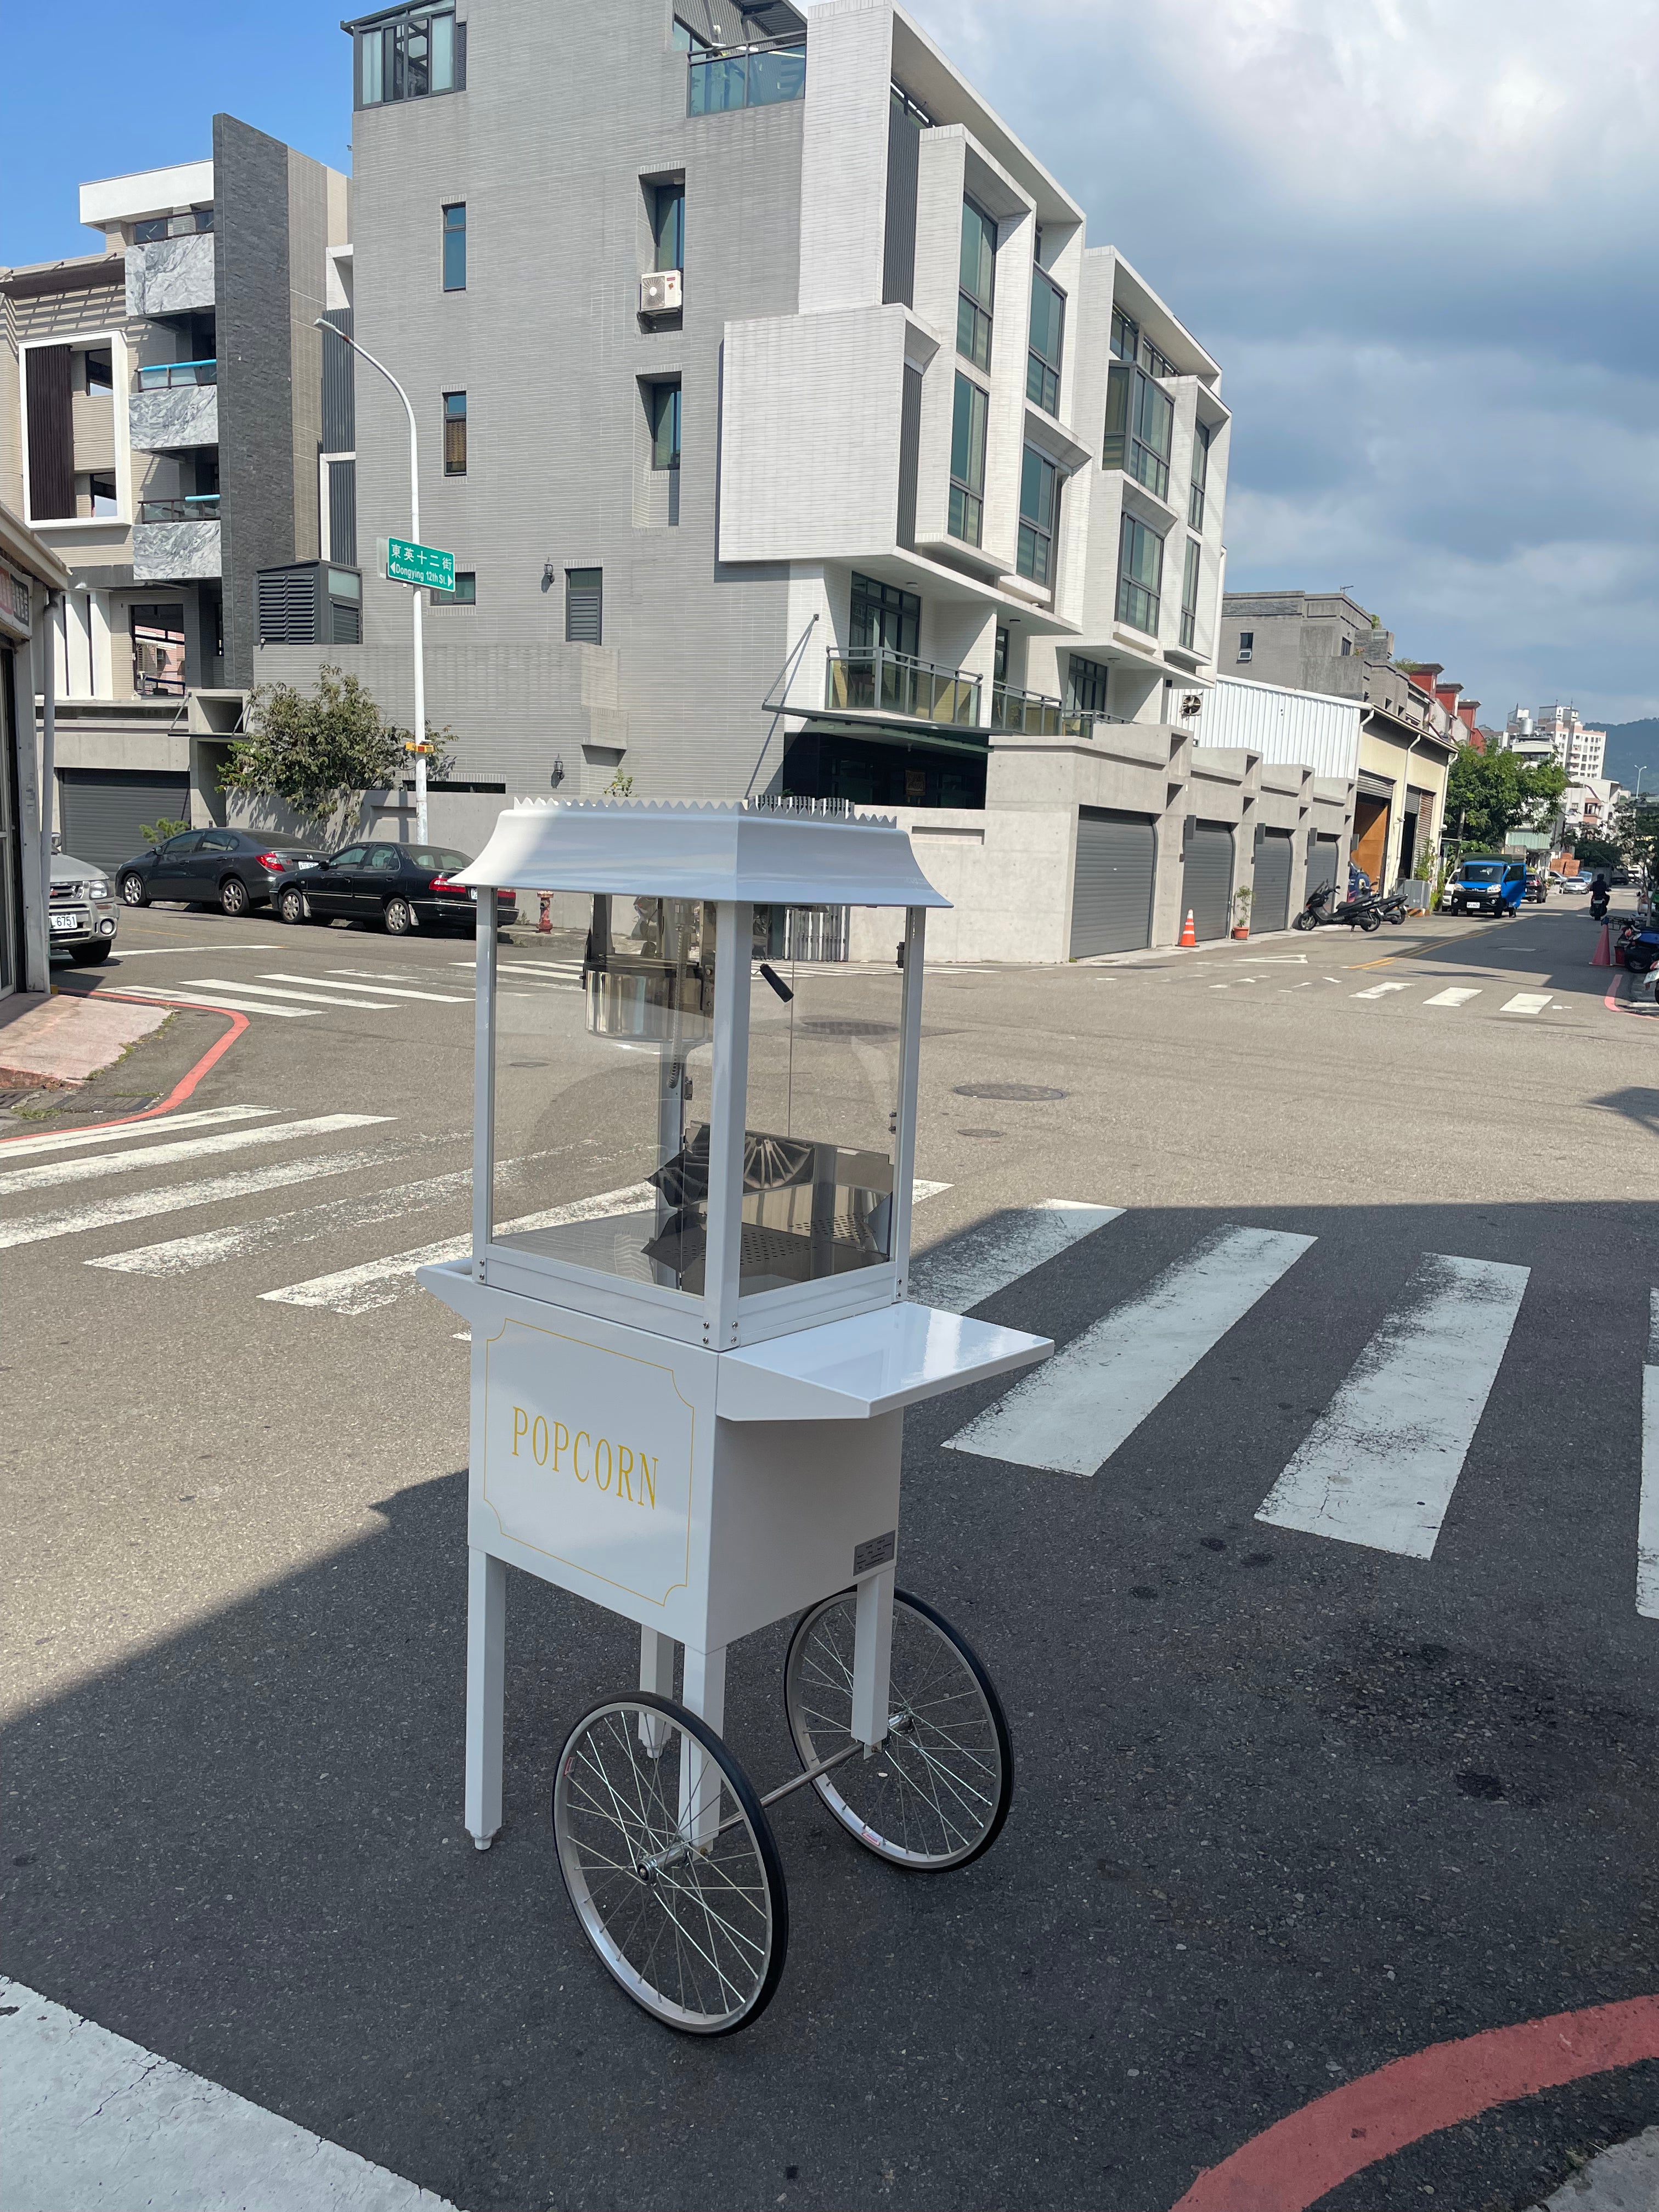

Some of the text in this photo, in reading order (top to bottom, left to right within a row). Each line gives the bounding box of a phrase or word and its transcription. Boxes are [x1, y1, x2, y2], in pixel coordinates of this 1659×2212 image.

[391, 544, 452, 571] 東英十二街
[396, 563, 424, 582] Dongying
[426, 571, 438, 583] 12th
[512, 1406, 658, 1509] POPCORN
